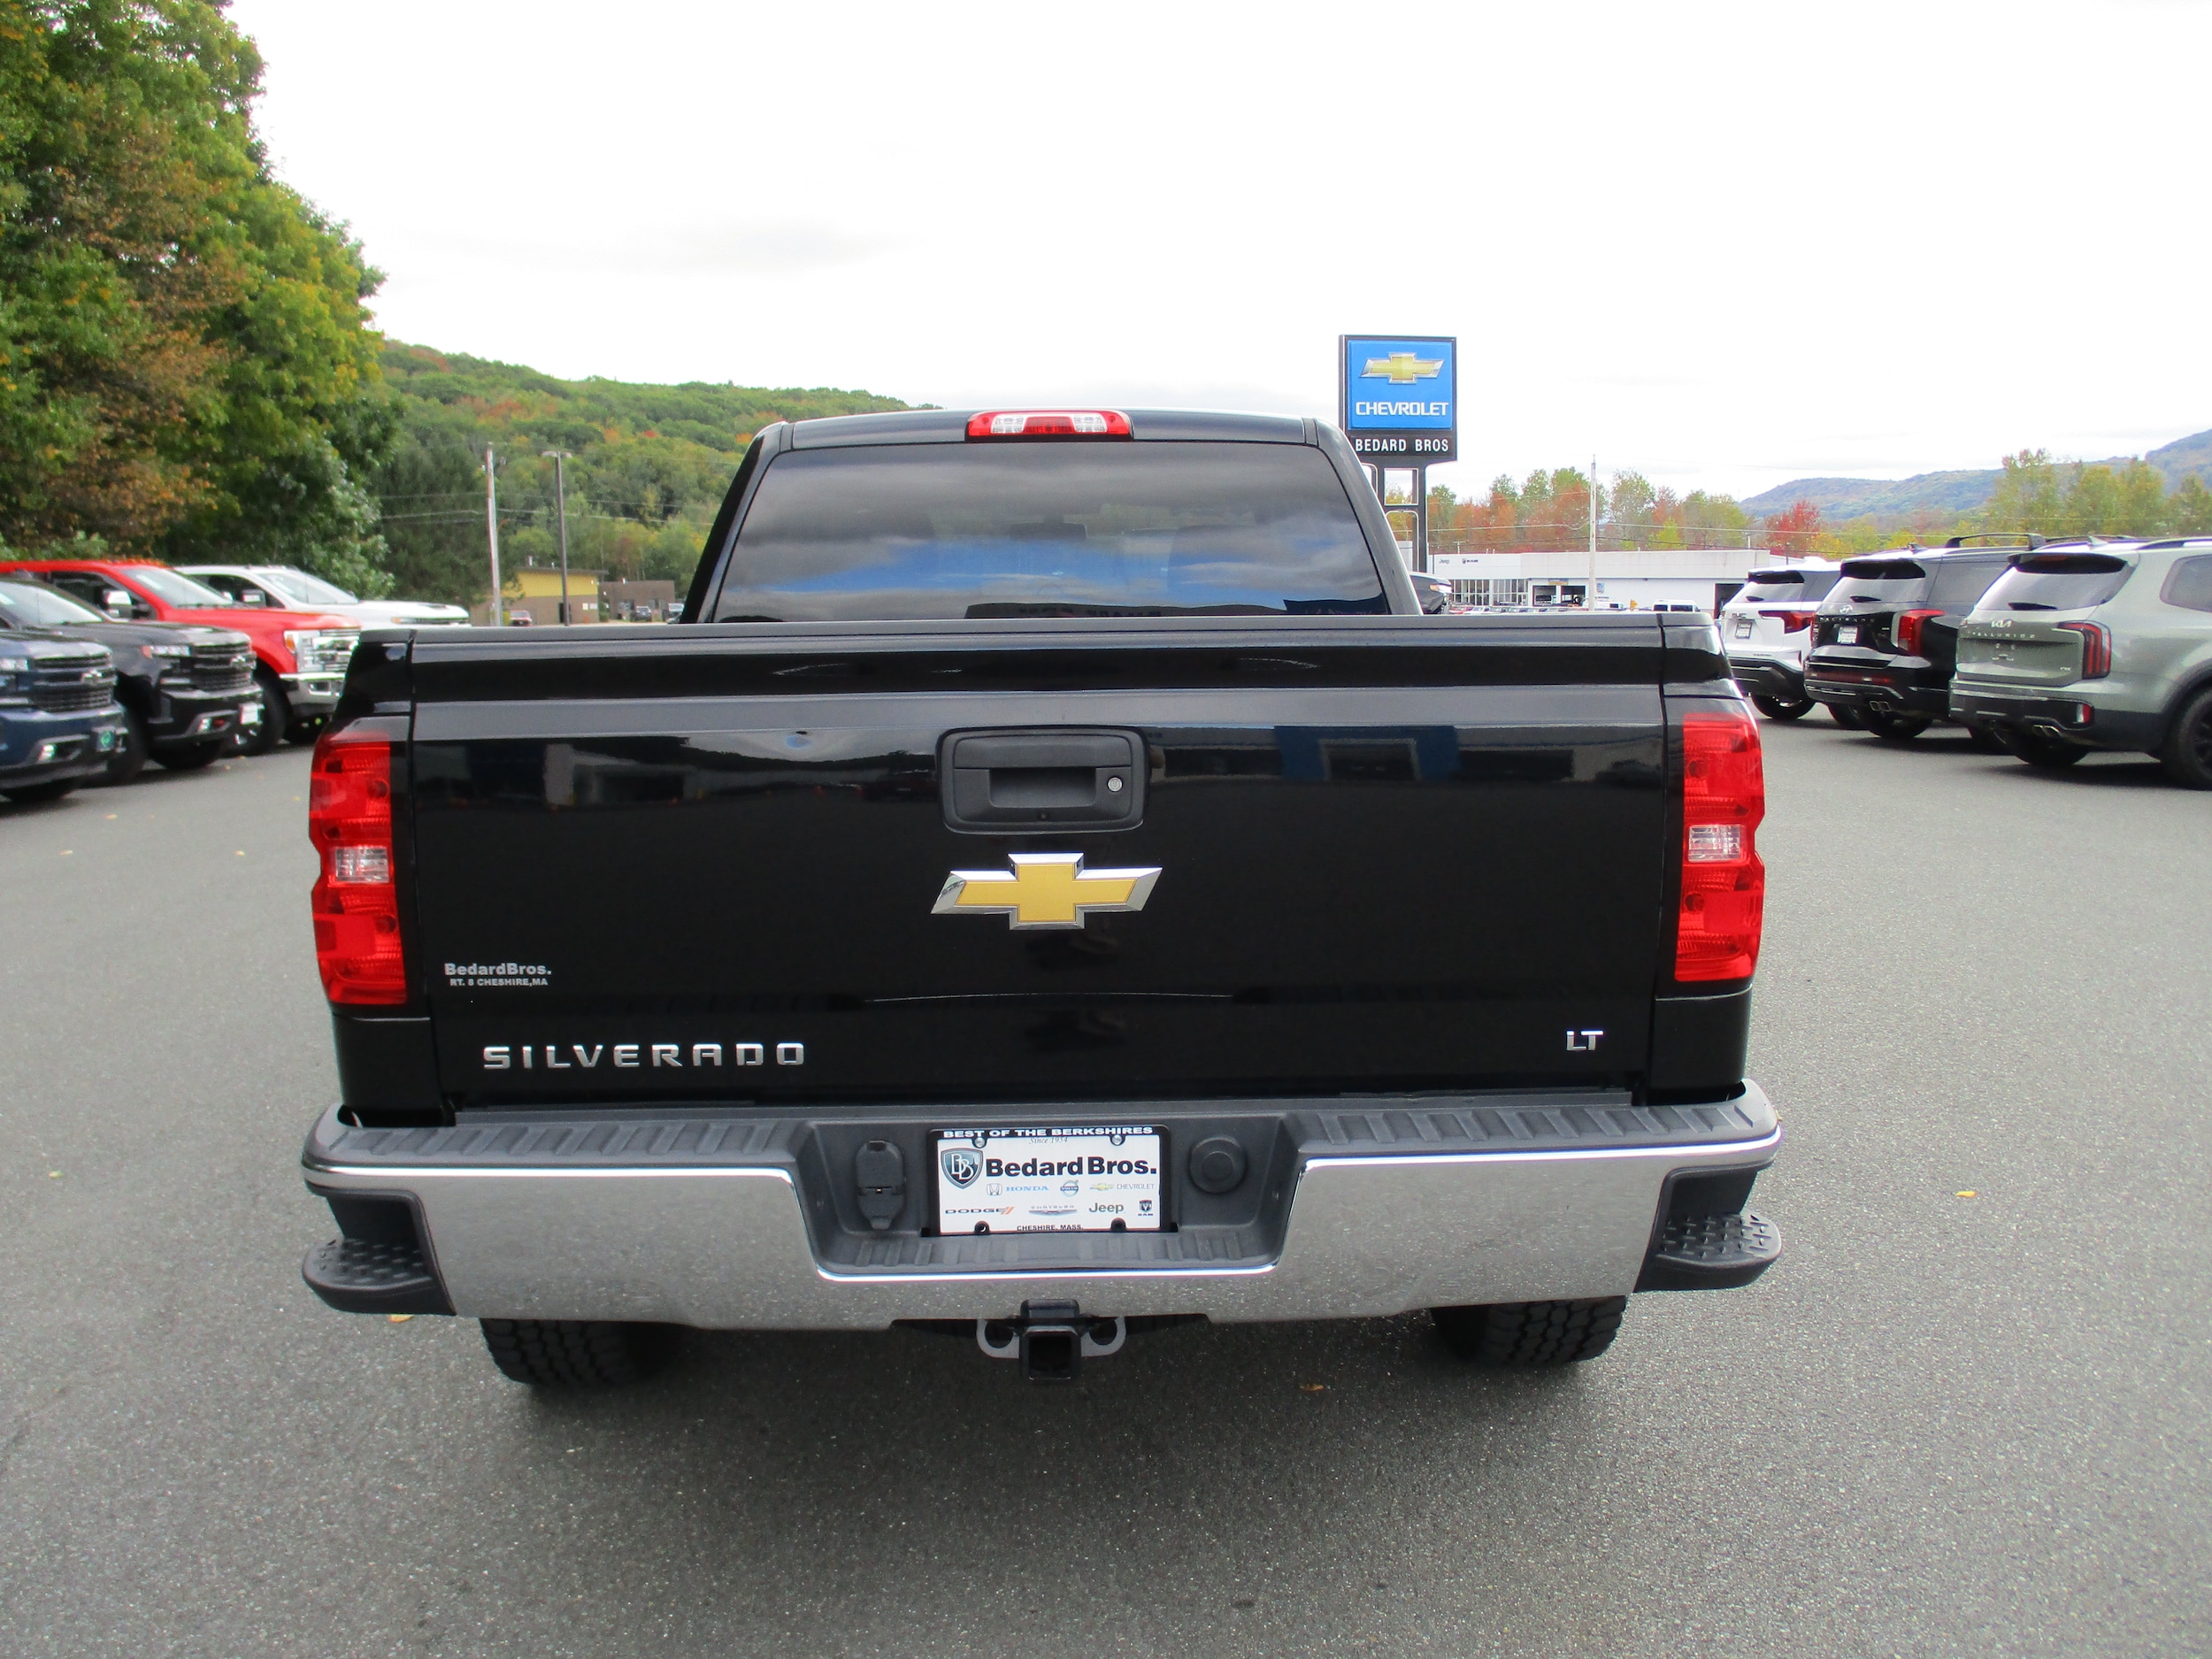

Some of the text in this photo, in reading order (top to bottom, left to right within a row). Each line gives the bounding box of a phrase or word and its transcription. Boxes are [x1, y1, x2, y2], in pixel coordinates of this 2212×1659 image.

[1356, 402, 1449, 416] CHEVROLET
[1355, 439, 1449, 452] BEDARD BROS
[1566, 1030, 1604, 1051] LT
[483, 1043, 805, 1070] SILVERADO
[943, 1130, 985, 1139] BEST
[1015, 1128, 1047, 1137] THE
[1051, 1126, 1154, 1136] BERKSHIRES
[986, 1156, 1157, 1178] Bedard Bros.
[1088, 1202, 1125, 1214] Jeep
